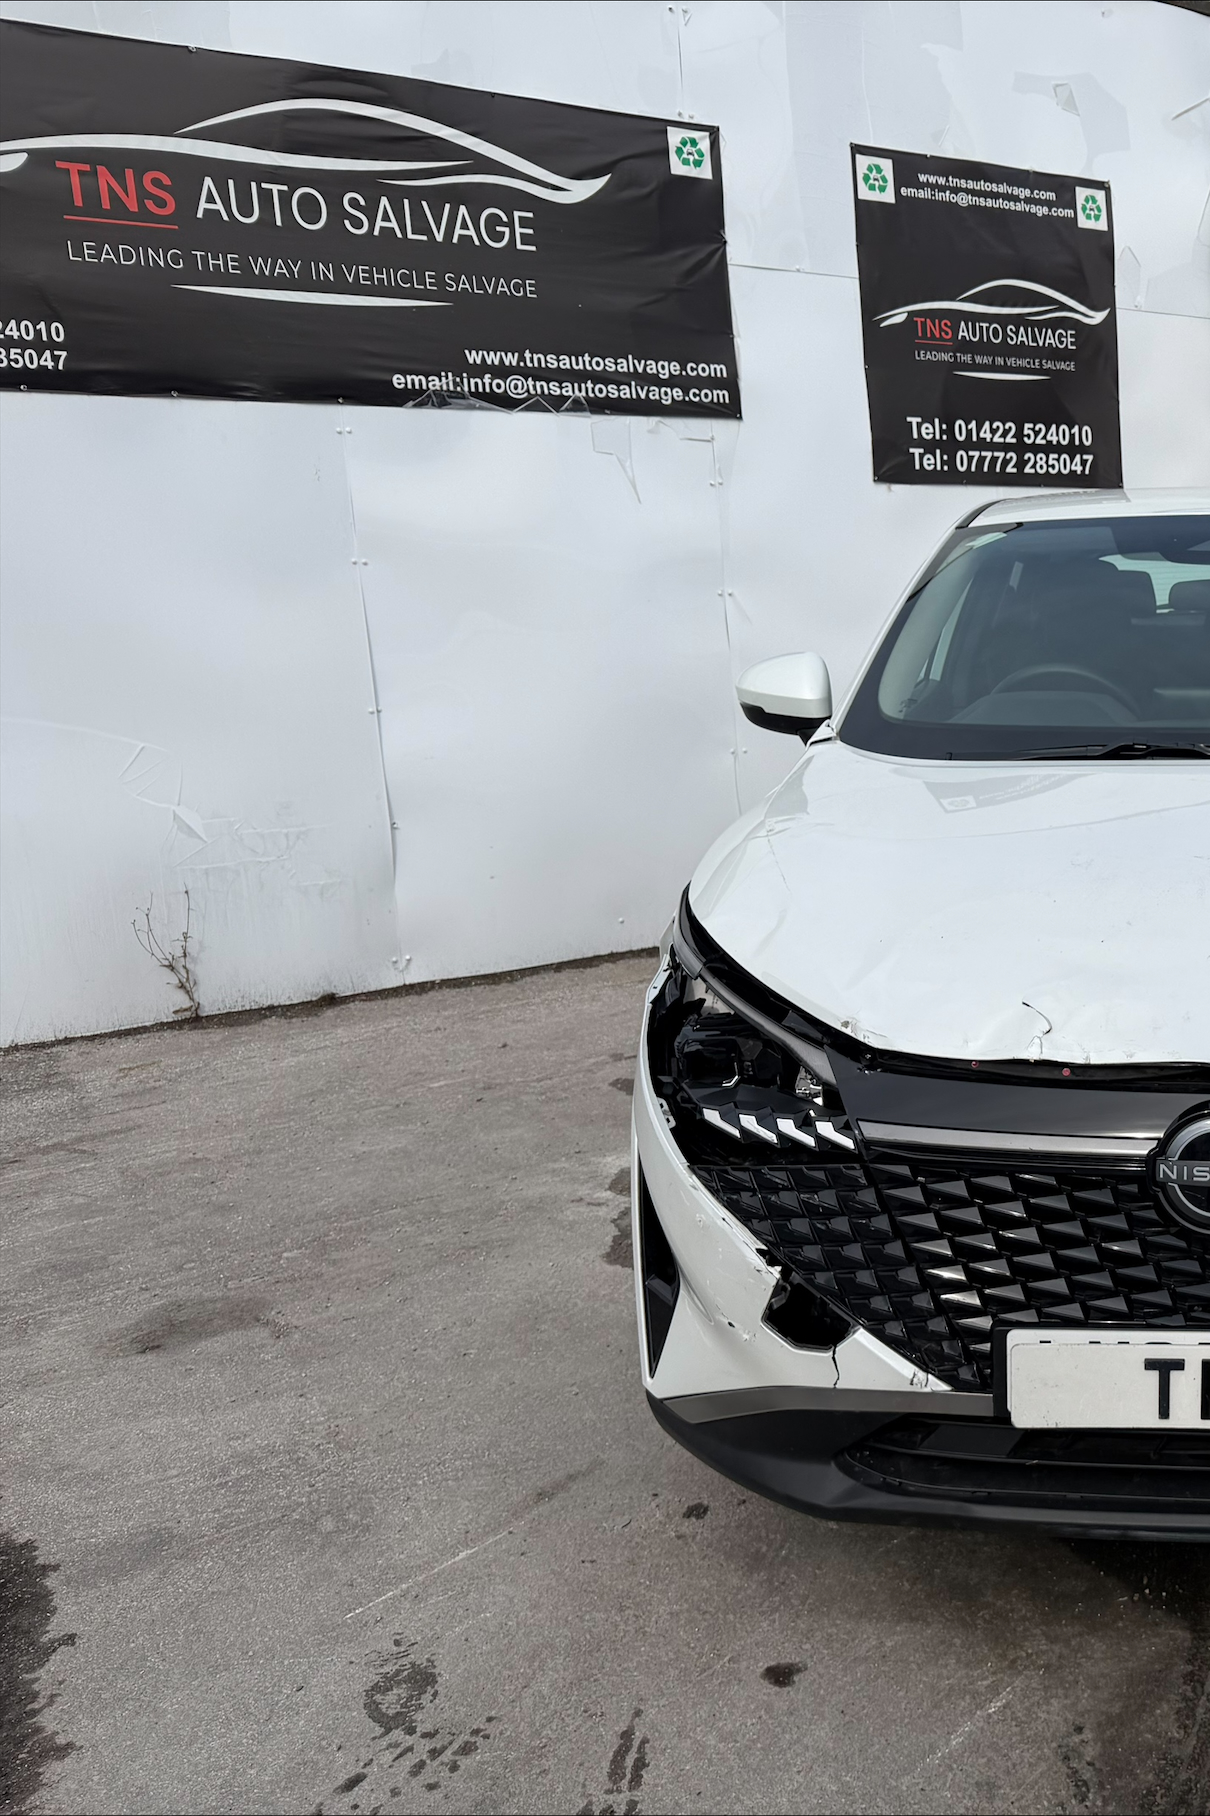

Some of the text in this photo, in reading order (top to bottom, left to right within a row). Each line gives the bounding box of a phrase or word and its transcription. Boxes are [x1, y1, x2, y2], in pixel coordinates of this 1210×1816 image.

[918, 173, 1056, 200] www.tnsautosalvage.com
[55, 161, 537, 251] TNS AUTO SALVAGE
[900, 186, 1074, 218] email:info@tnsautosalvage.com
[67, 240, 538, 298] LEADING THE WAY IN VEHICLE SALVAGE
[0, 319, 65, 342] 4010
[914, 317, 1076, 349] TNS AUTO SALVAGE
[464, 349, 727, 378] www.tnsautosalvage.com
[915, 350, 1076, 371] LEADING THE WAY IN VEHICLE SALVAGE
[392, 372, 730, 404] email:info@tnsautosalvage.com
[906, 417, 1092, 446] Tel: 01422 524010
[909, 448, 1093, 474] Tel: 07772 285047
